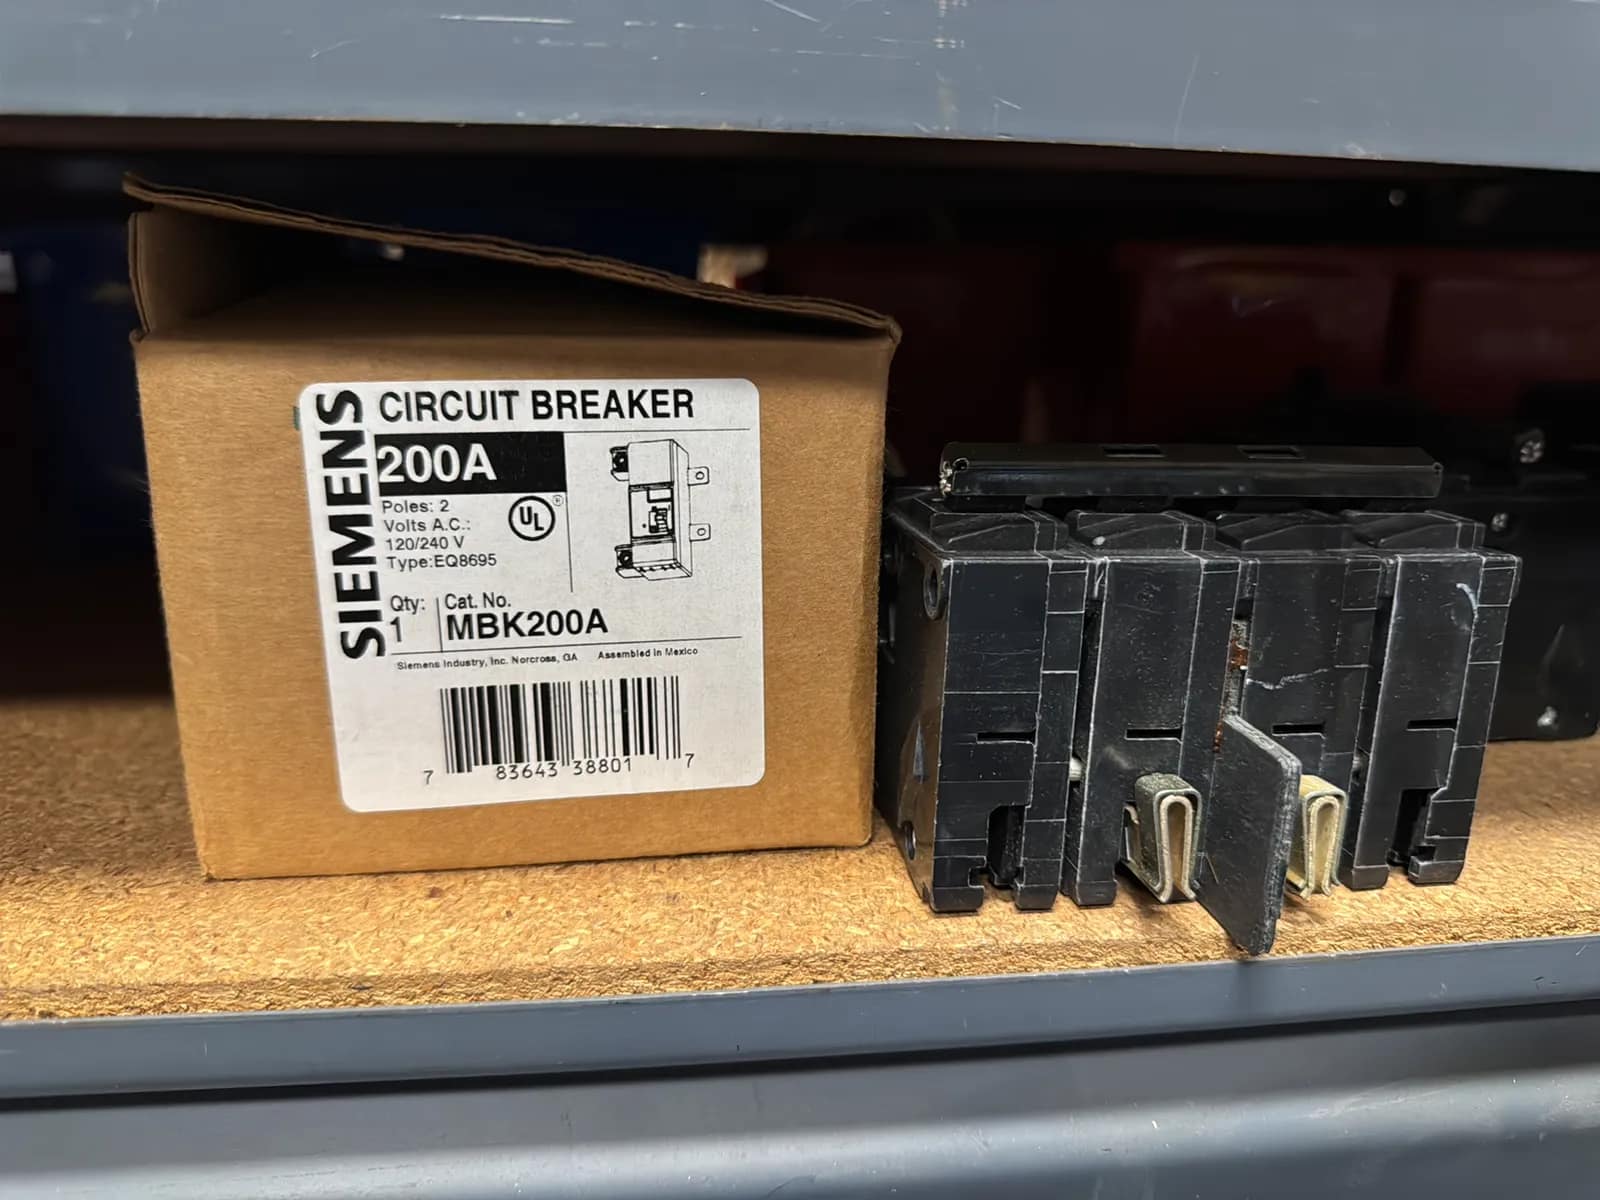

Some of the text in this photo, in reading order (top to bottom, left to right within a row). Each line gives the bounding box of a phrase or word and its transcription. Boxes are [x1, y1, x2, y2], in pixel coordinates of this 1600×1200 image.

[379, 388, 695, 423] CIRCUIT BREAKER
[376, 443, 498, 484] 200A
[381, 500, 450, 515] Poles: 2
[316, 389, 386, 659] SIEMENS
[384, 516, 472, 533] Volts A.C.:
[386, 535, 465, 551] 120/240 V
[386, 553, 497, 571] Type:EQ8695
[390, 595, 426, 614] Qty:
[444, 592, 512, 610] Cat. No.
[390, 616, 402, 643] 1
[446, 608, 609, 642] MBK200A
[397, 660, 441, 671] Siemens
[442, 656, 488, 670] Industry,
[490, 656, 508, 667] Inc.
[511, 654, 561, 667] Norcross,
[598, 650, 652, 660] Assembled
[664, 648, 699, 657] Mexico
[424, 753, 695, 785] 7 83643 38801 7
